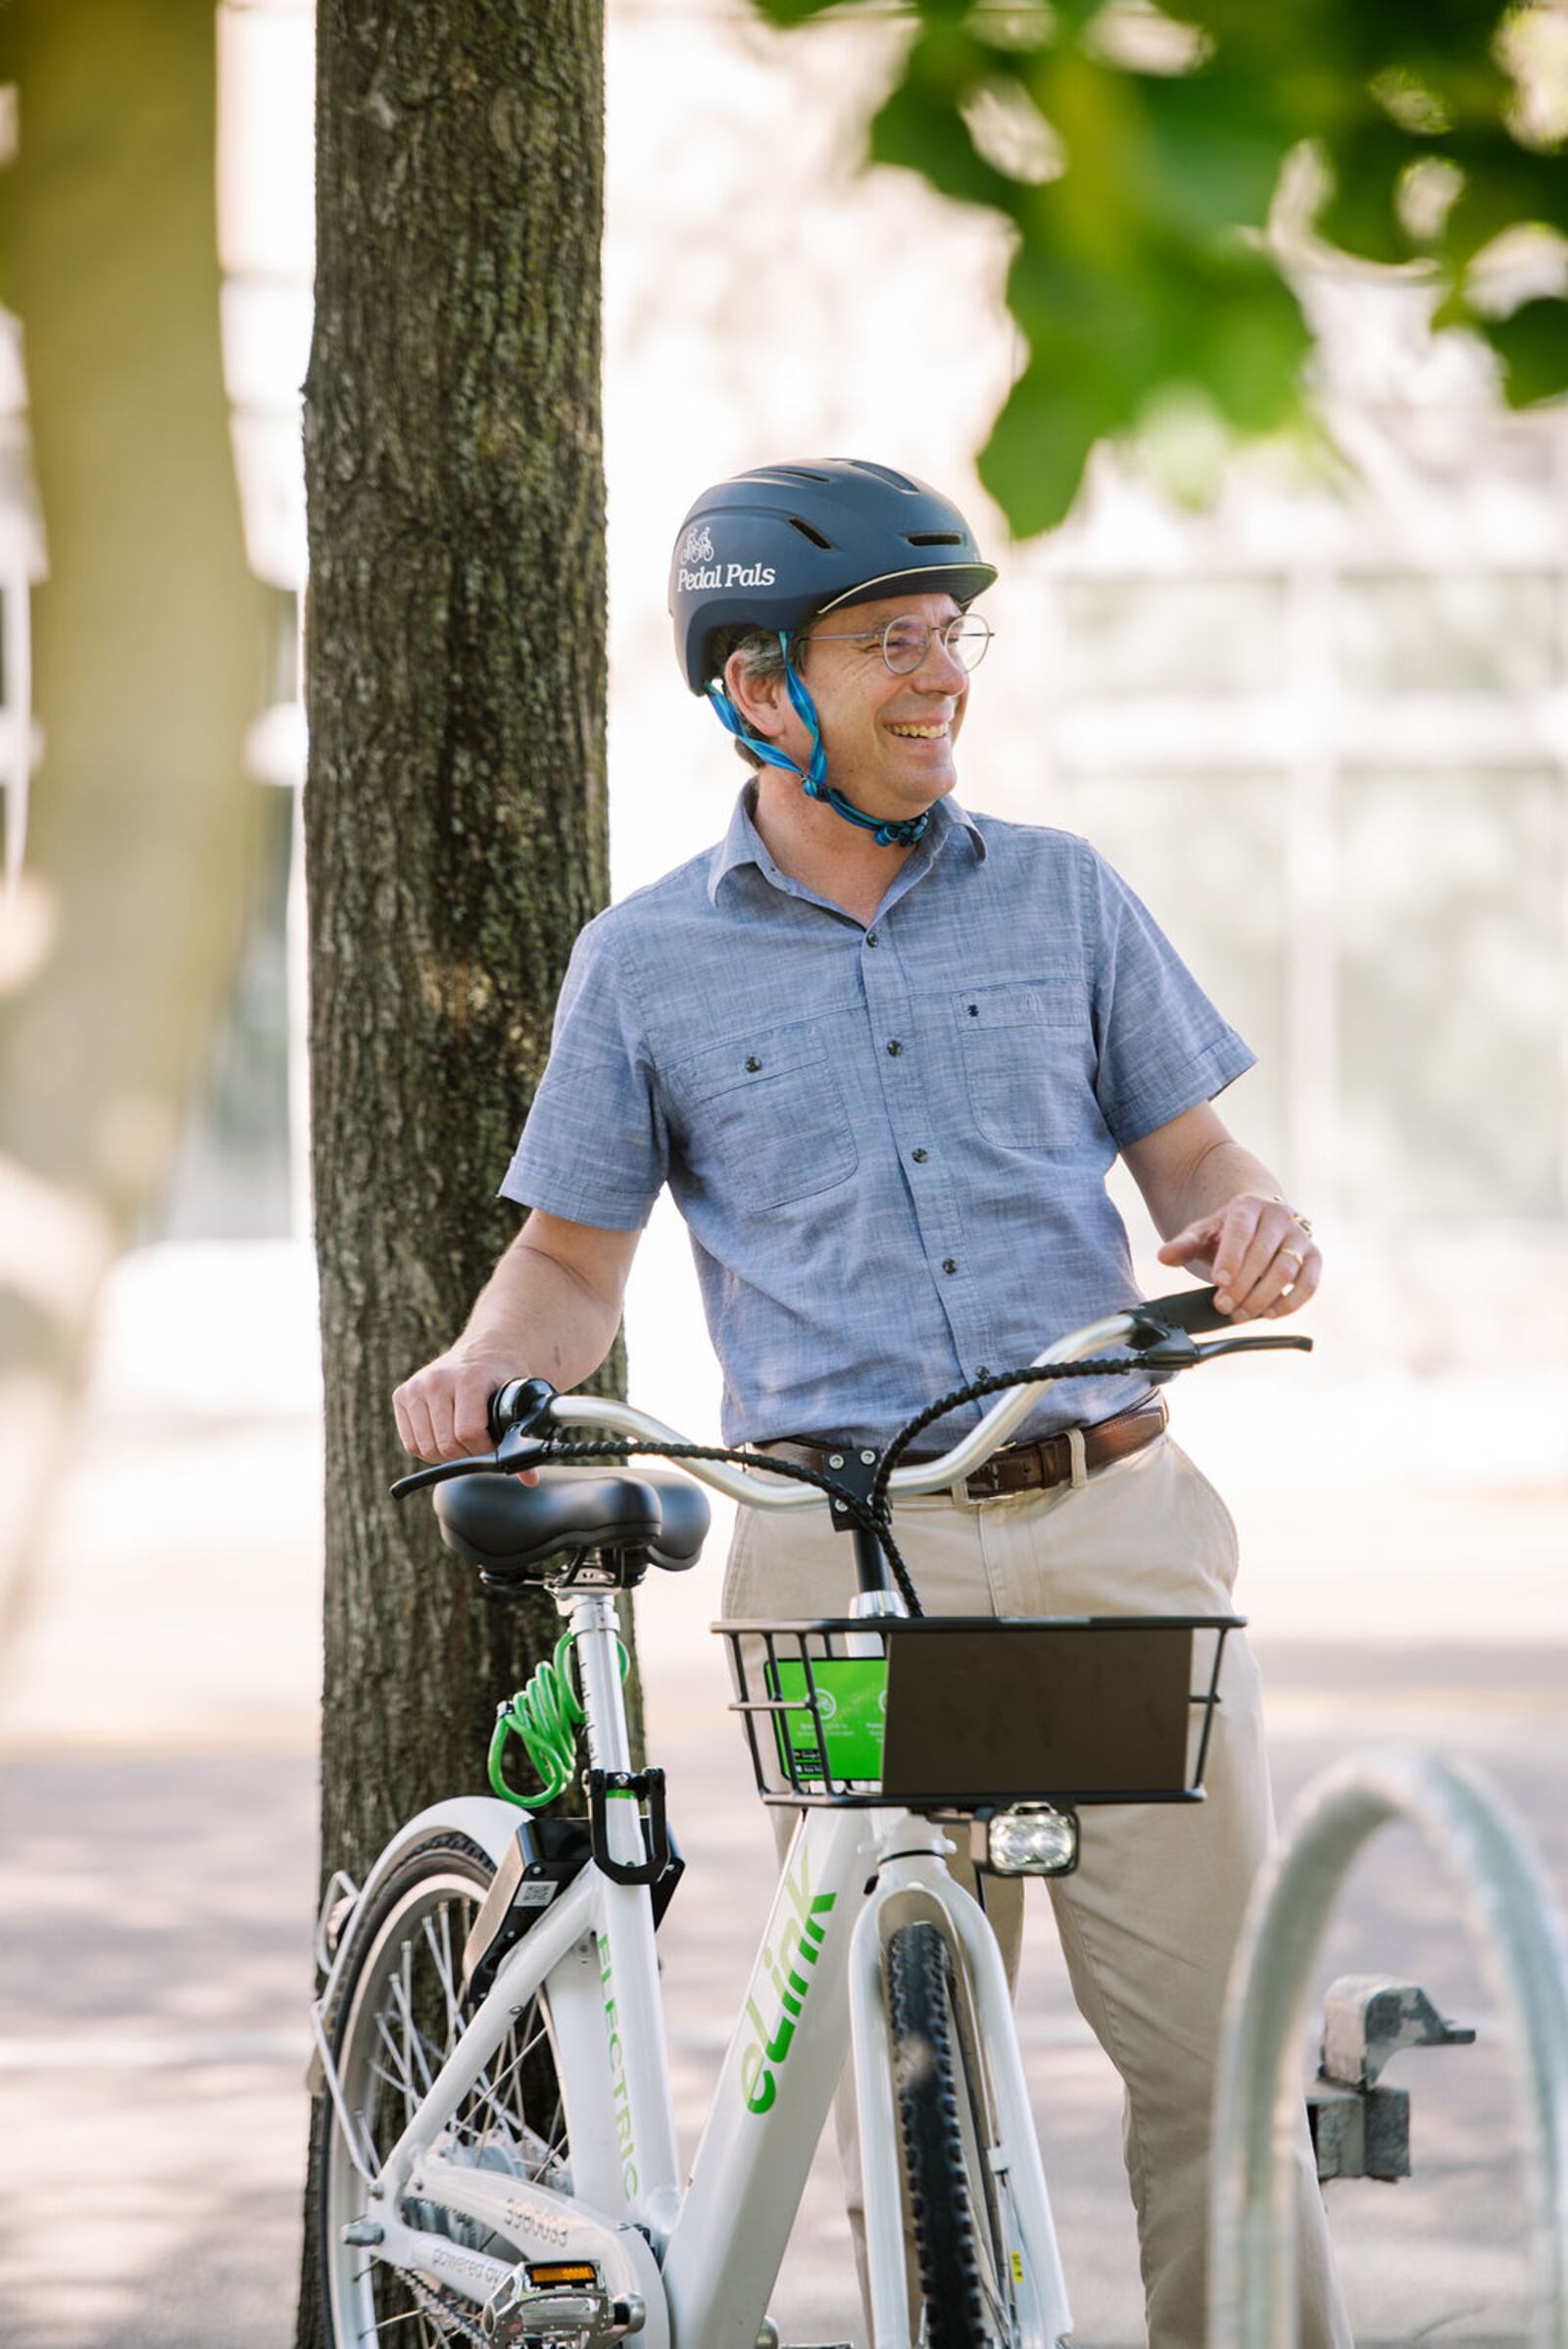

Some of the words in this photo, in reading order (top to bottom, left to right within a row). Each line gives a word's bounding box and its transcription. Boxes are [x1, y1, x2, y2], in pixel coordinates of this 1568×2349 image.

[678, 564, 721, 592] Pedal
[724, 563, 776, 587] Pals
[597, 1933, 638, 2202] ELECTRIC
